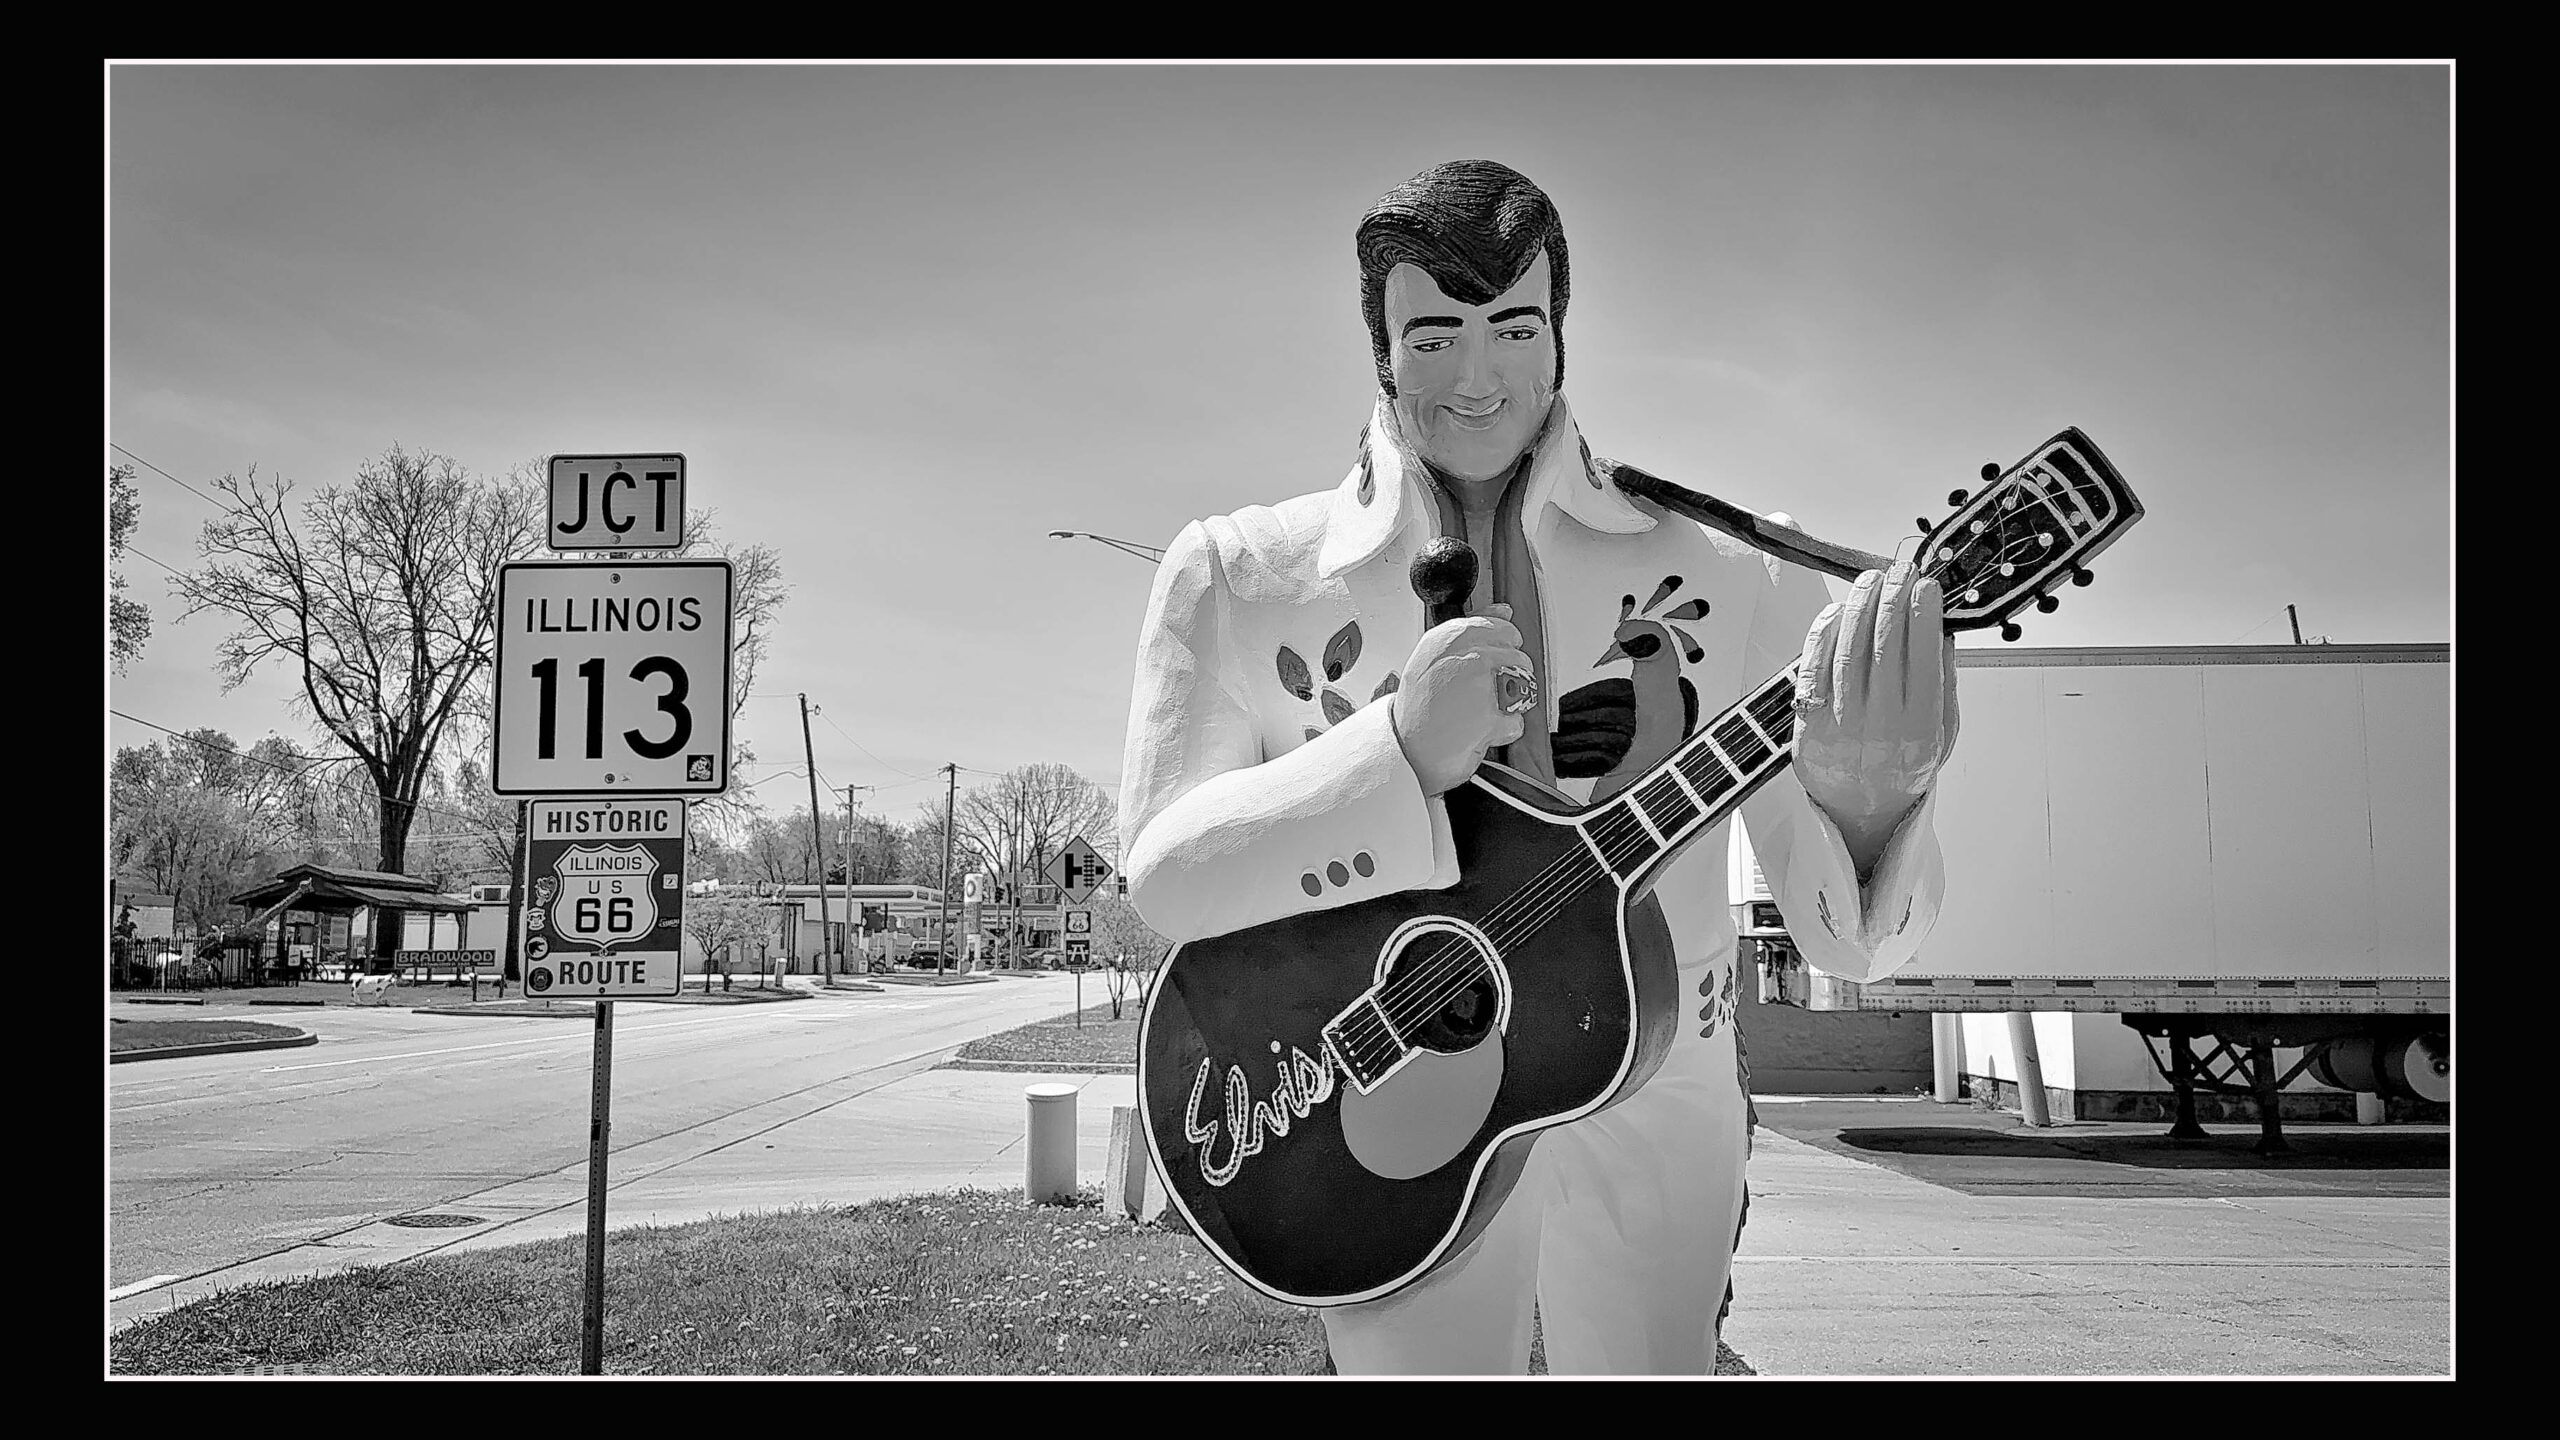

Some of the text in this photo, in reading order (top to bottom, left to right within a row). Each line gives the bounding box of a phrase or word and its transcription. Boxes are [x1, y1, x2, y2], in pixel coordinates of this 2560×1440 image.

[556, 471, 677, 534] JCT
[526, 597, 702, 633] ILLINOIS
[531, 656, 693, 760] 113
[547, 809, 668, 833] HISTORIC
[570, 856, 642, 871] ILLINOIS
[589, 880, 623, 894] U S
[575, 897, 634, 933] 66
[399, 951, 493, 962] BRAIDWOOD
[559, 960, 646, 985] ROUTE
[1185, 1040, 1335, 1187] Elvis
